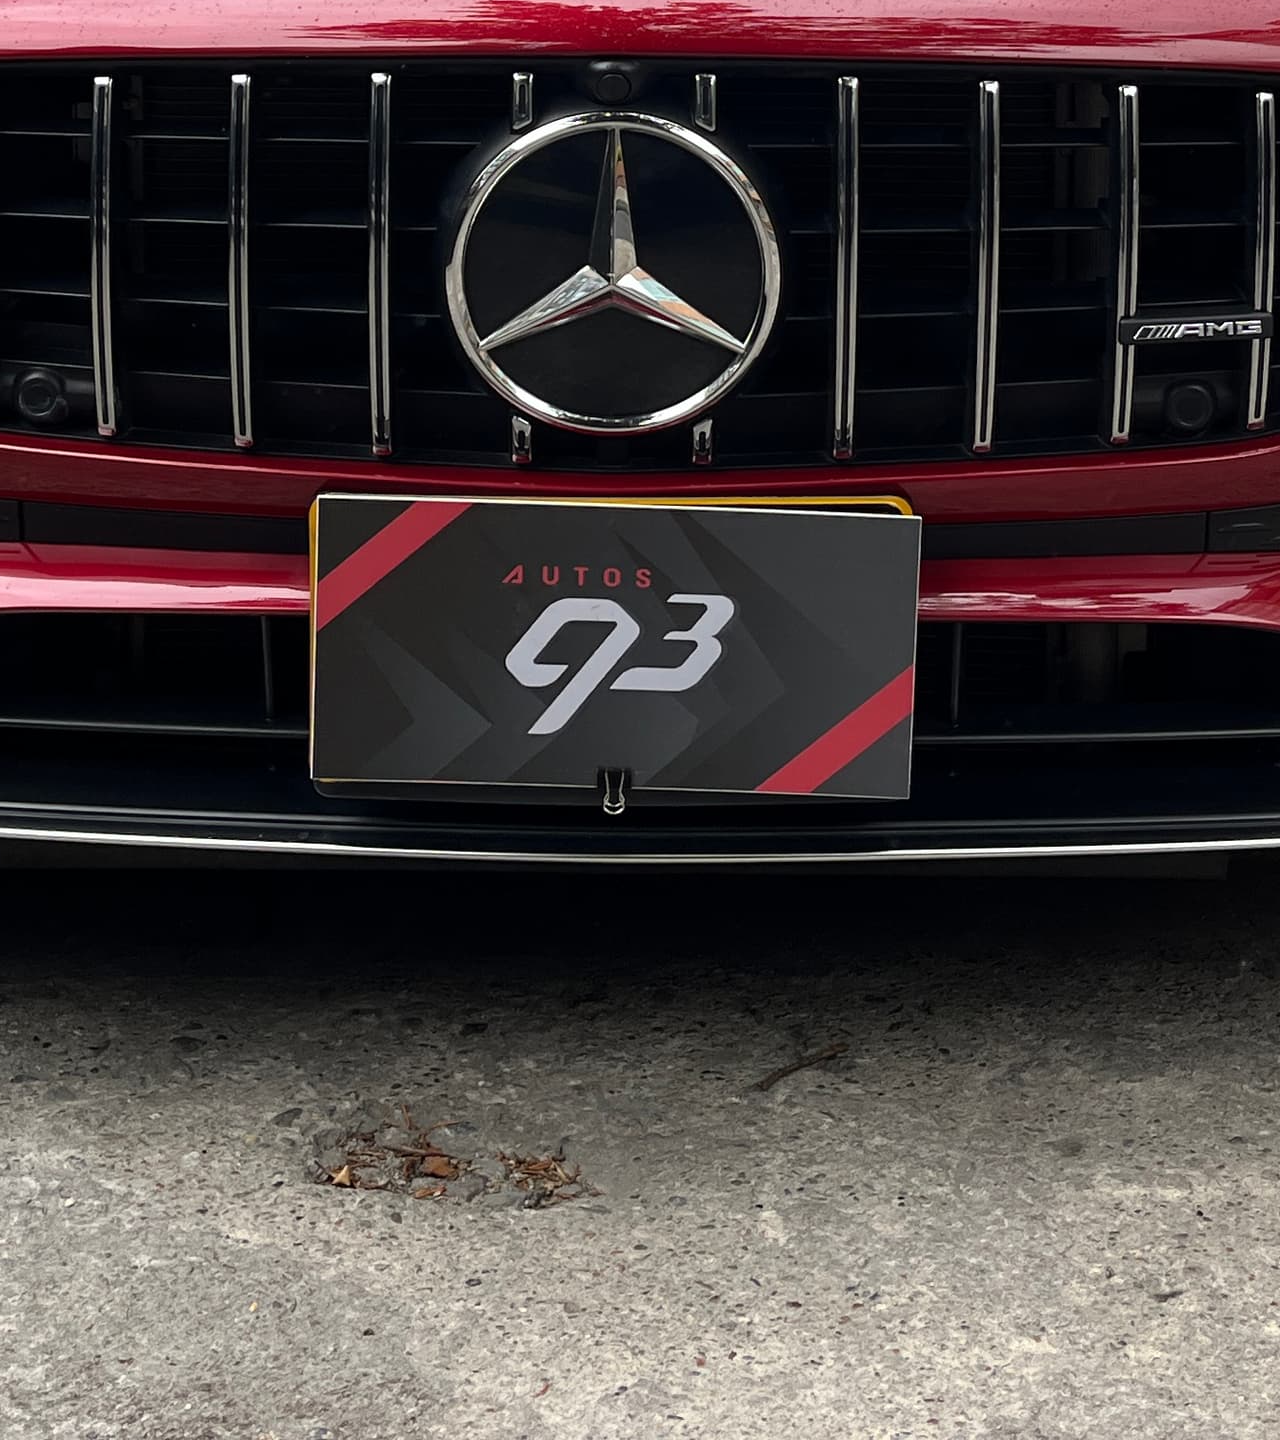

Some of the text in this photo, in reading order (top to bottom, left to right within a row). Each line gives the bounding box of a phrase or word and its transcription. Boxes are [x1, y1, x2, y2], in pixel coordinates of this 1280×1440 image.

[1174, 319, 1262, 339] AMG
[501, 563, 653, 589] AUTOS
[504, 593, 736, 735] 93
